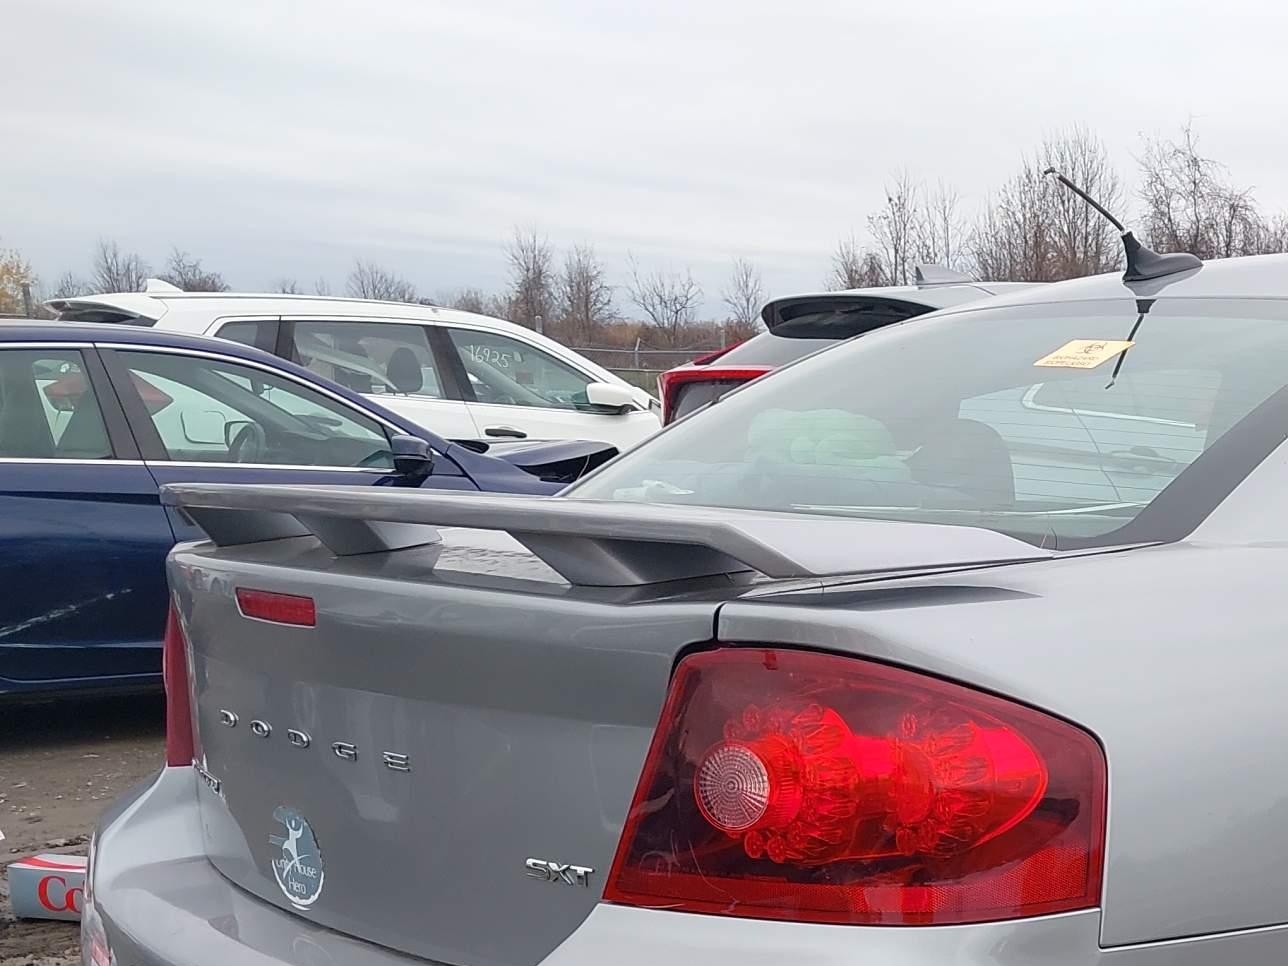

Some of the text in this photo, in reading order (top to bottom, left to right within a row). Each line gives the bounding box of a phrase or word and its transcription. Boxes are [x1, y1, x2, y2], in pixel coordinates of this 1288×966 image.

[469, 344, 512, 368] 16925
[219, 708, 411, 773] DODGE
[525, 858, 595, 887] SXT
